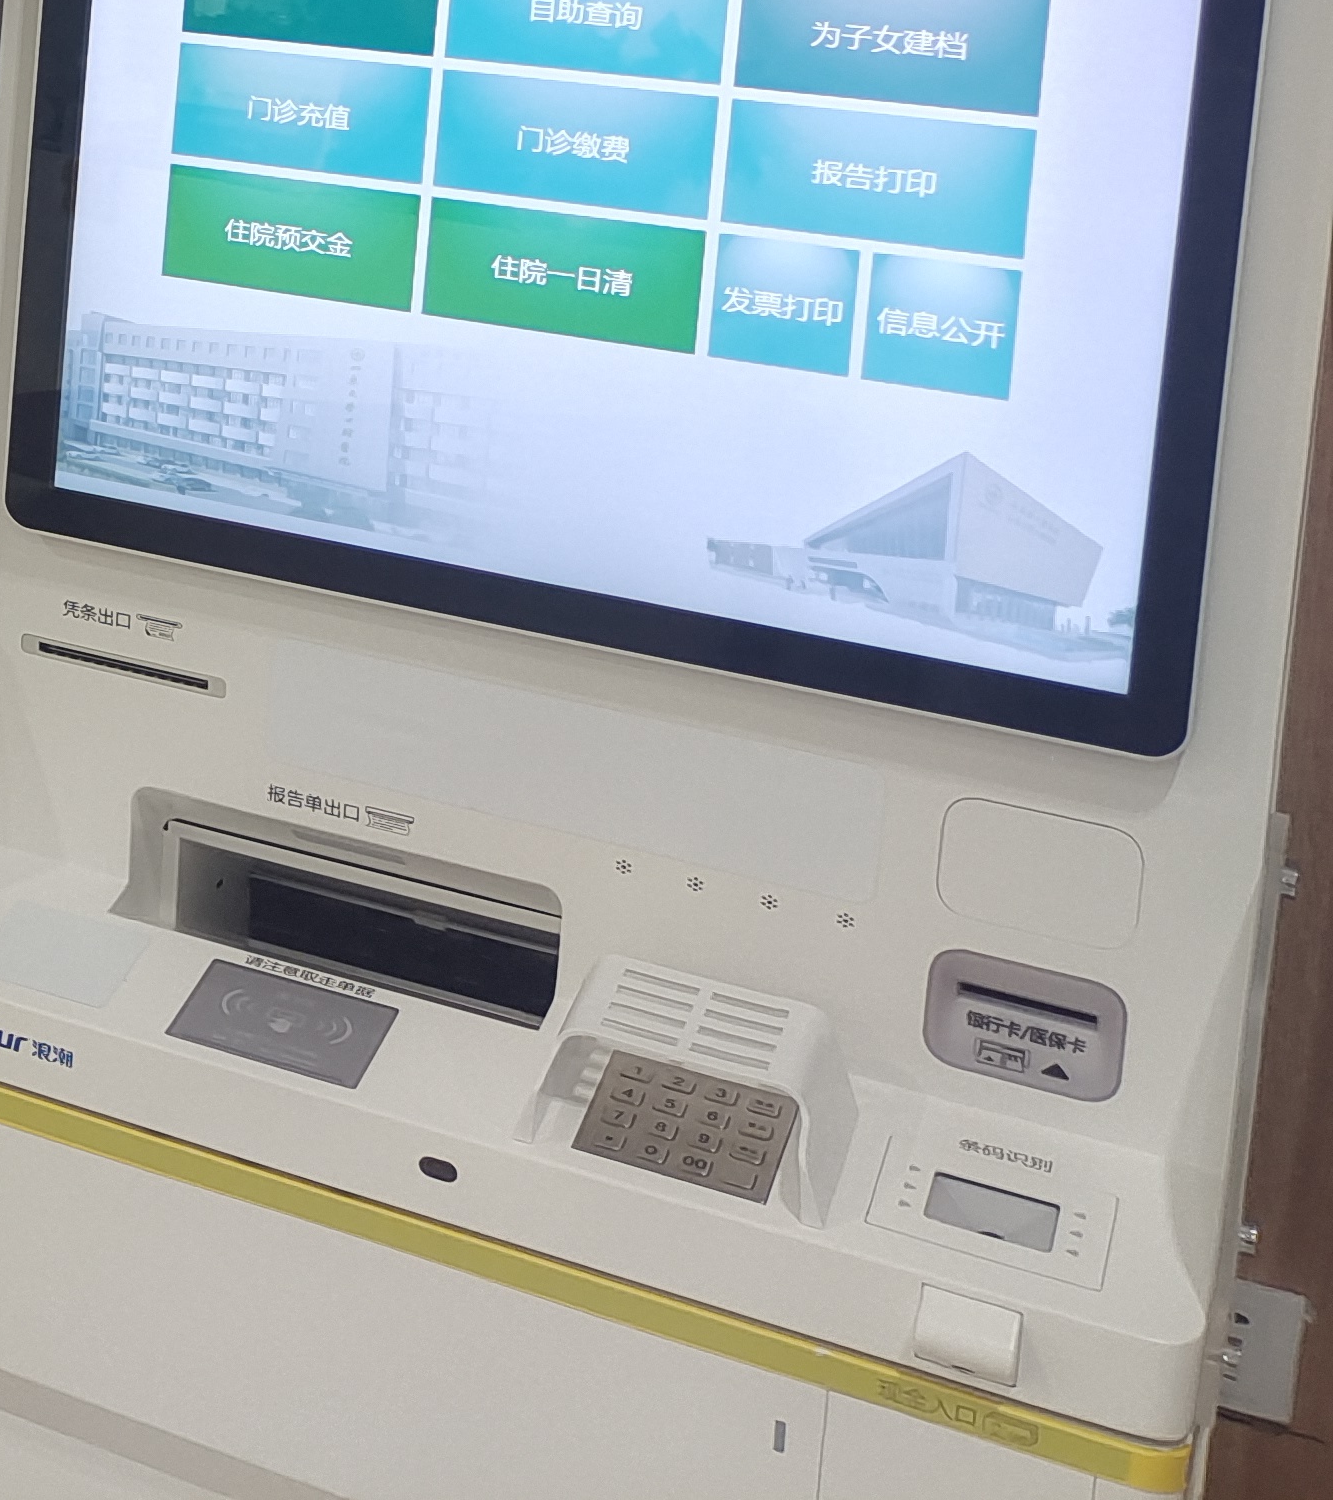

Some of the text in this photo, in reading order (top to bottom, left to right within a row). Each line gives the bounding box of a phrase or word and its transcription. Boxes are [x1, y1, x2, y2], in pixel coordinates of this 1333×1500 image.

[811, 20, 969, 62] 为子女建档
[246, 96, 350, 132] 门诊充值
[516, 125, 630, 164] 门诊缴费
[812, 158, 937, 198] 报告打印
[225, 218, 354, 259] 住院预交金
[491, 254, 633, 299] 住院一日清
[722, 286, 844, 328] 发票打印
[877, 306, 1006, 351] 信息公开
[63, 598, 132, 631] 凭条出口
[266, 783, 361, 823] 报告单出口
[966, 1009, 1088, 1054] 银行卡/医保卡
[31, 1039, 74, 1069] 浪潮
[959, 1138, 1054, 1174] 条码识别
